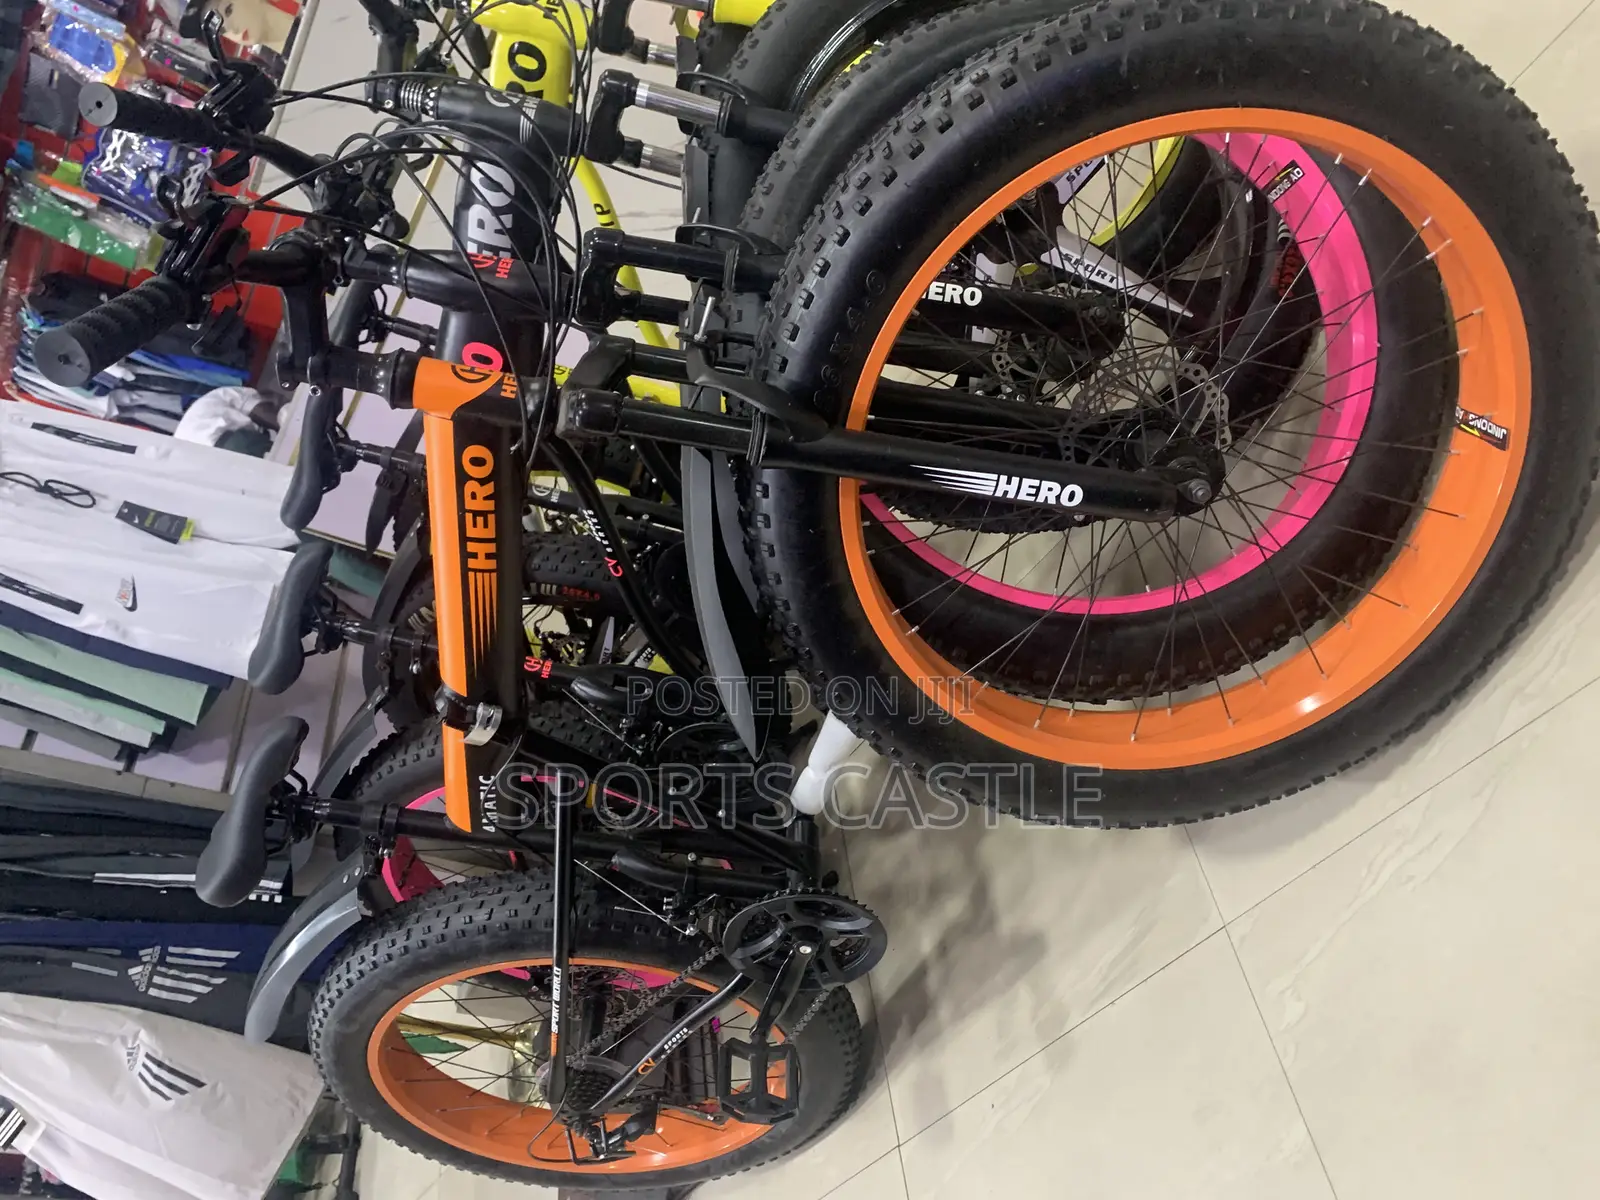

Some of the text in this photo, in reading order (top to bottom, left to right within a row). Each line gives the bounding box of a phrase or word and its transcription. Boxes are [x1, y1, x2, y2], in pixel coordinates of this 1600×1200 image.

[1062, 252, 1118, 284] SPORT
[921, 281, 983, 307] ERO
[995, 474, 1084, 507] HERO
[462, 445, 497, 570] HERO
[604, 556, 623, 577] CV
[552, 966, 562, 1002] WORLD
[551, 1000, 560, 1034] SPORT
[663, 1027, 688, 1051] SPORTS
[637, 1057, 656, 1075] CV
